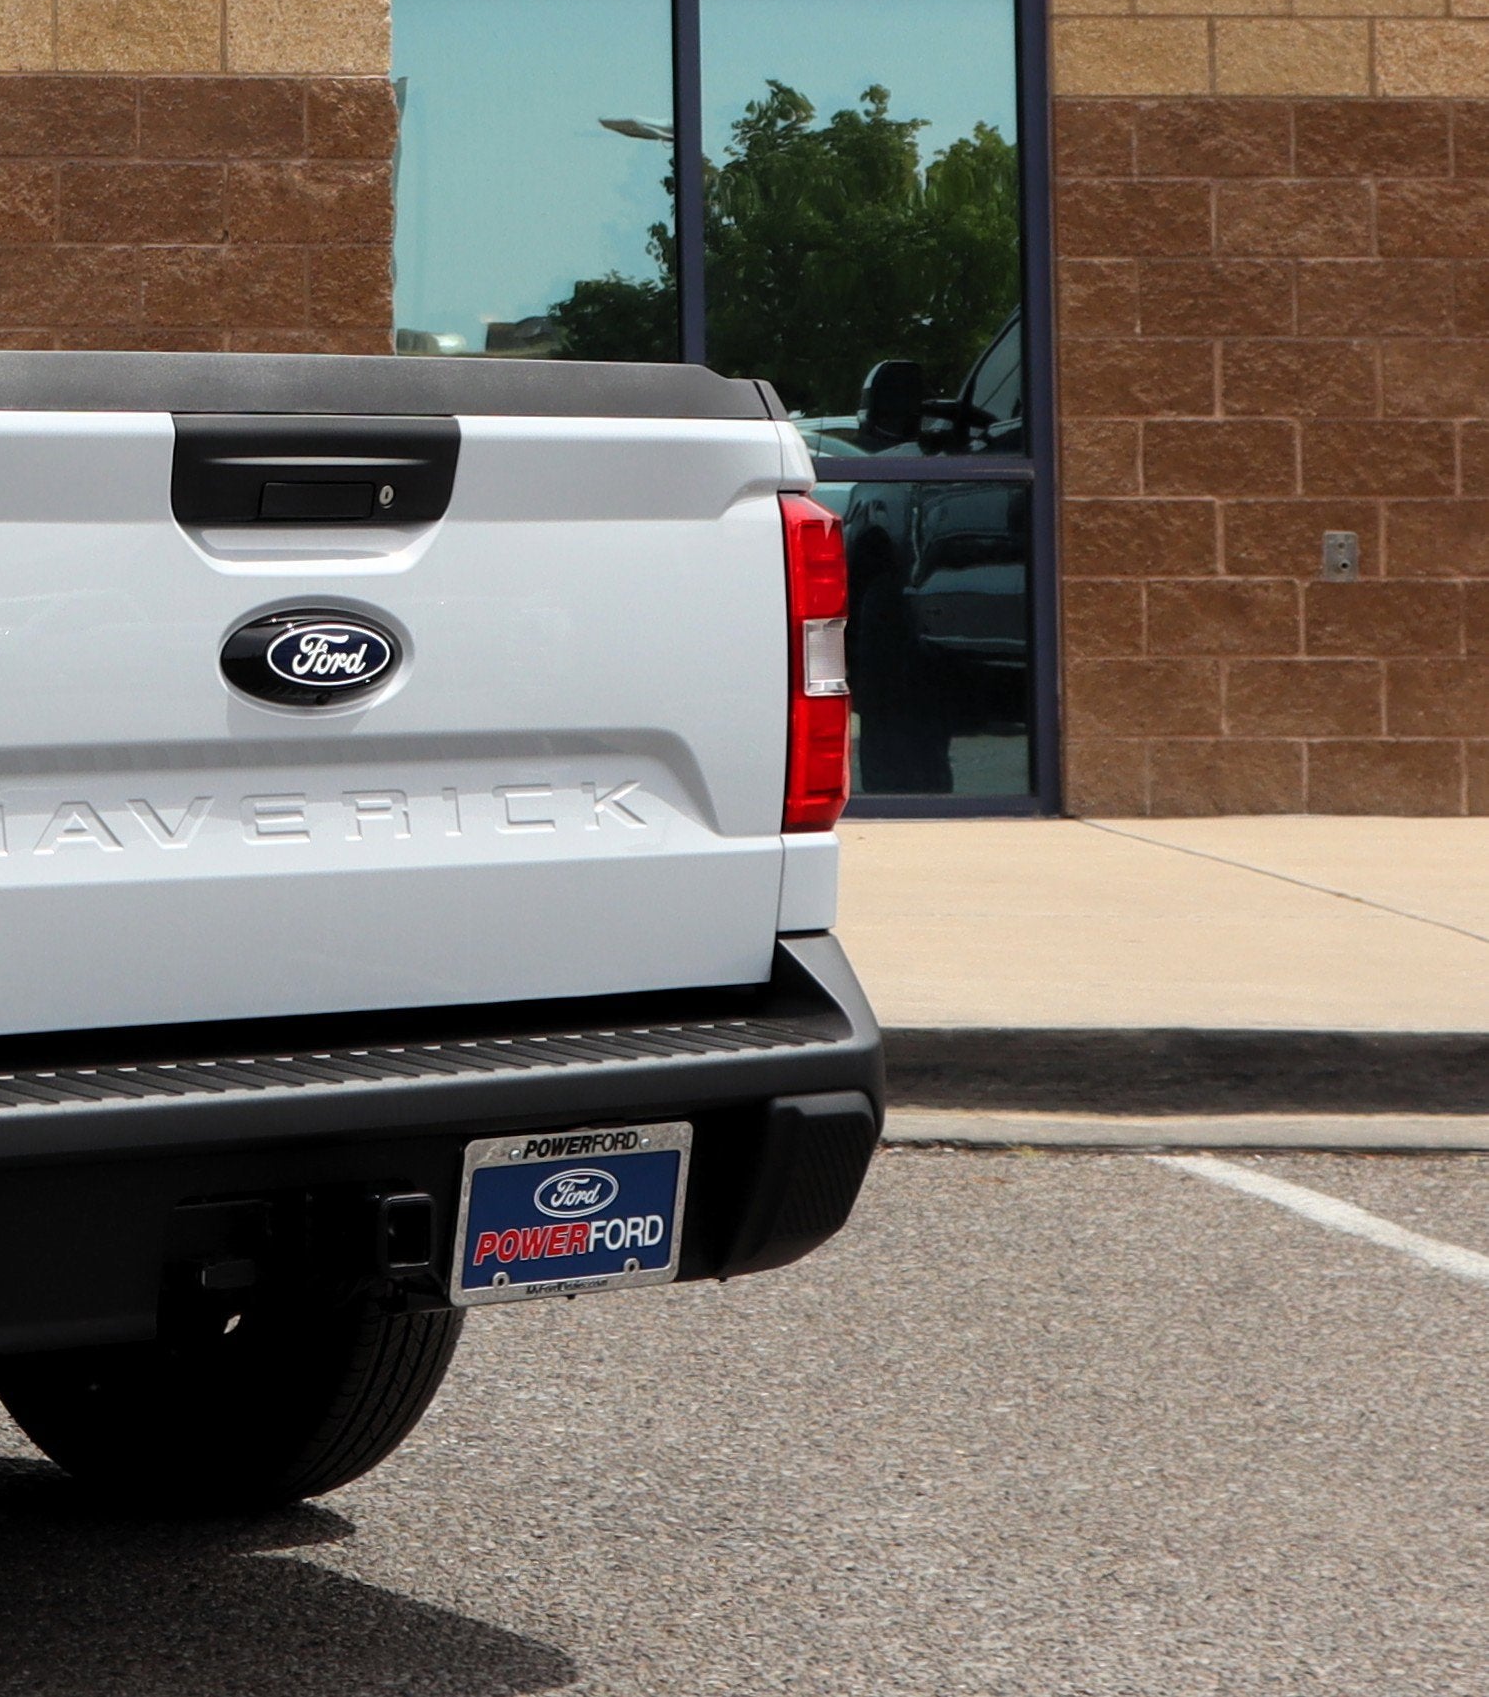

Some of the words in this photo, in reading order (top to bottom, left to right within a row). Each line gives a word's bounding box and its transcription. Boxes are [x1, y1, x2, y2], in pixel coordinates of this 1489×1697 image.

[292, 632, 367, 678] Ford
[523, 1131, 639, 1160] POWERFORD
[550, 1178, 602, 1208] Ford
[473, 1214, 664, 1267] POWERFORD
